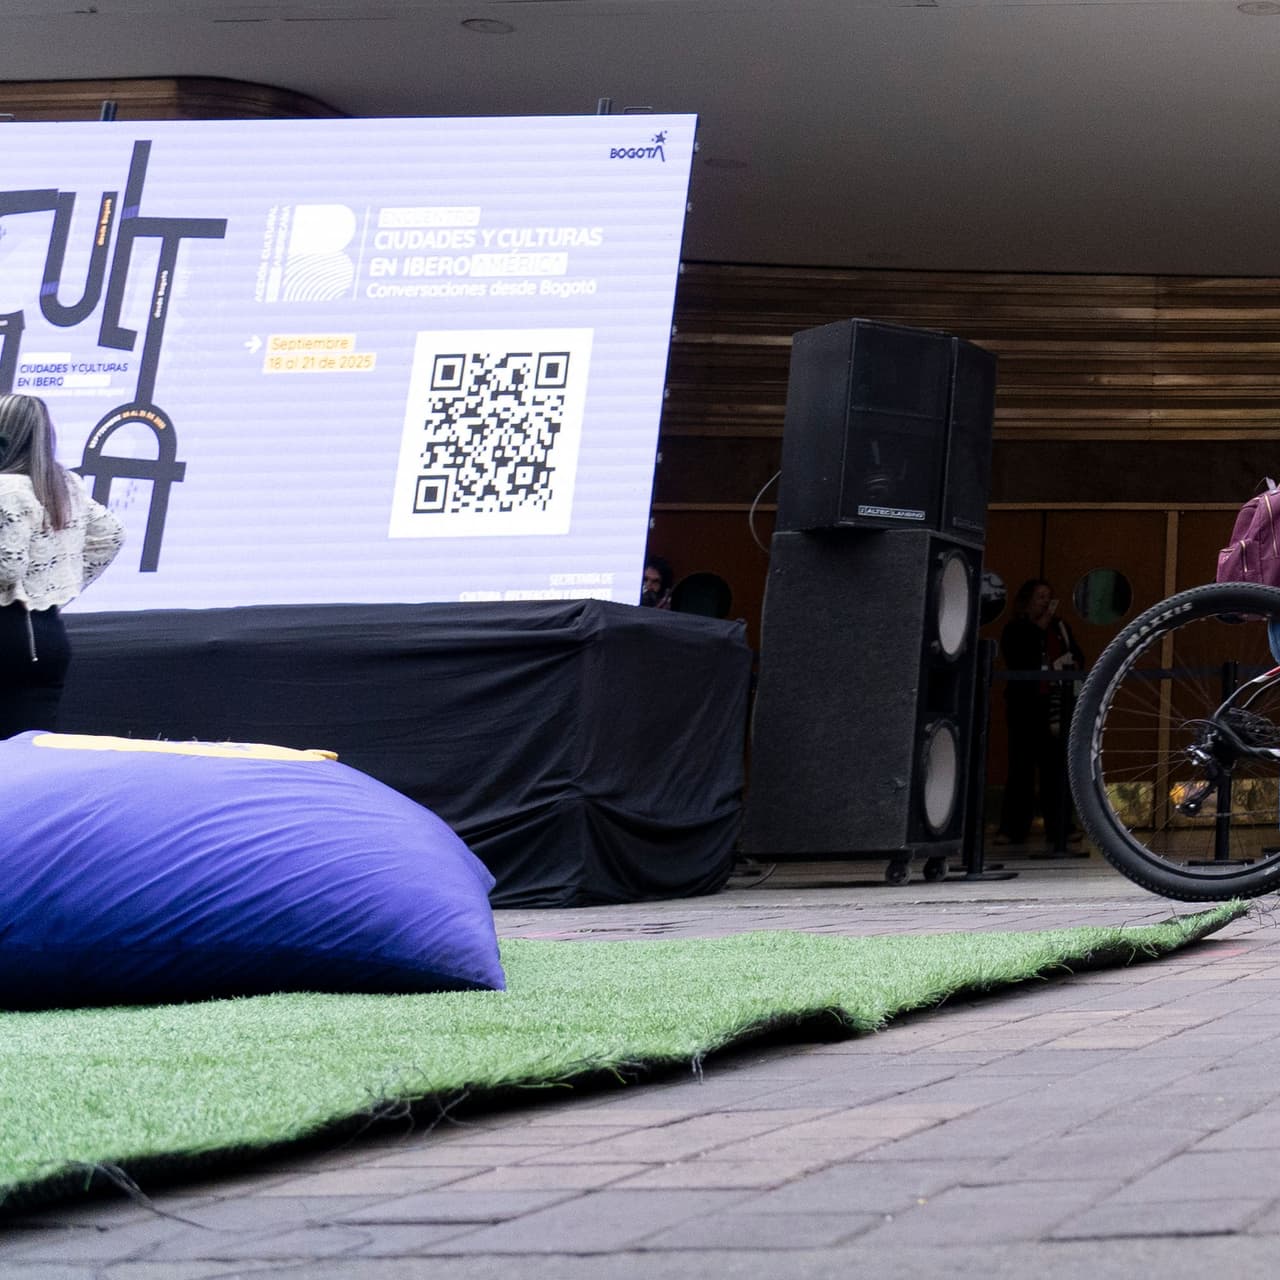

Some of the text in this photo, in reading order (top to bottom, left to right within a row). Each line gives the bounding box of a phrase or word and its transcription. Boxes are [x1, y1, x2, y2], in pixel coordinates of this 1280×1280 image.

[373, 226, 604, 250] CIUDADES Y CULTURAS
[369, 257, 397, 277] EN
[366, 281, 487, 298] Conversaciones
[489, 280, 537, 297] desde
[272, 337, 350, 352] Septiembre
[20, 363, 129, 374] CIUDADES Y CULTURAS
[269, 355, 373, 370] 18 al 21 de 2025
[17, 377, 30, 387] EN
[1125, 602, 1193, 648] MAXXIS
